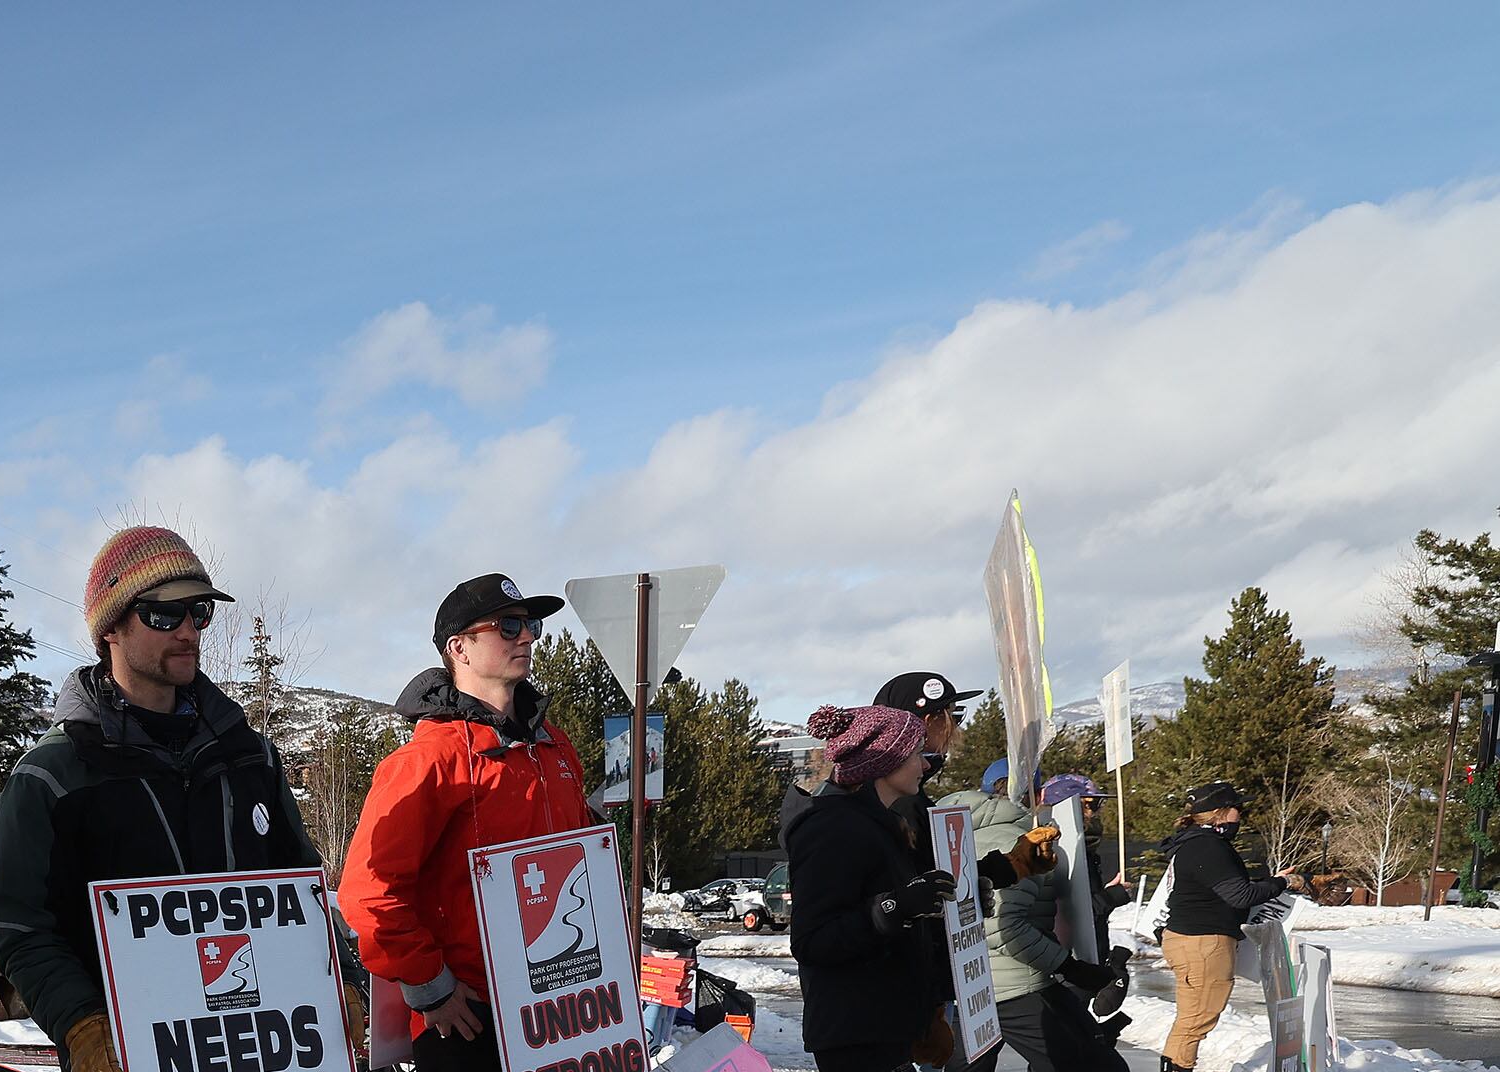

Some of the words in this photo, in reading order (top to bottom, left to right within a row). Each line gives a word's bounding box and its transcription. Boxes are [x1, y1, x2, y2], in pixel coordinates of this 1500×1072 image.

[127, 883, 306, 939] PCPSPA
[526, 895, 548, 906] PCPSPA
[952, 921, 986, 954] FIGHTING
[530, 965, 546, 977] PARK
[546, 962, 559, 973] CITY
[559, 953, 600, 970] PROFESSIONAL
[532, 977, 543, 986] SKI
[543, 972, 564, 984] PATROL
[565, 962, 601, 978] ASSOCIATION
[963, 960, 980, 983] FOR
[980, 956, 986, 975] A
[520, 981, 623, 1049] UNION
[967, 986, 991, 1017] LIVING
[974, 1018, 995, 1049] WAGE
